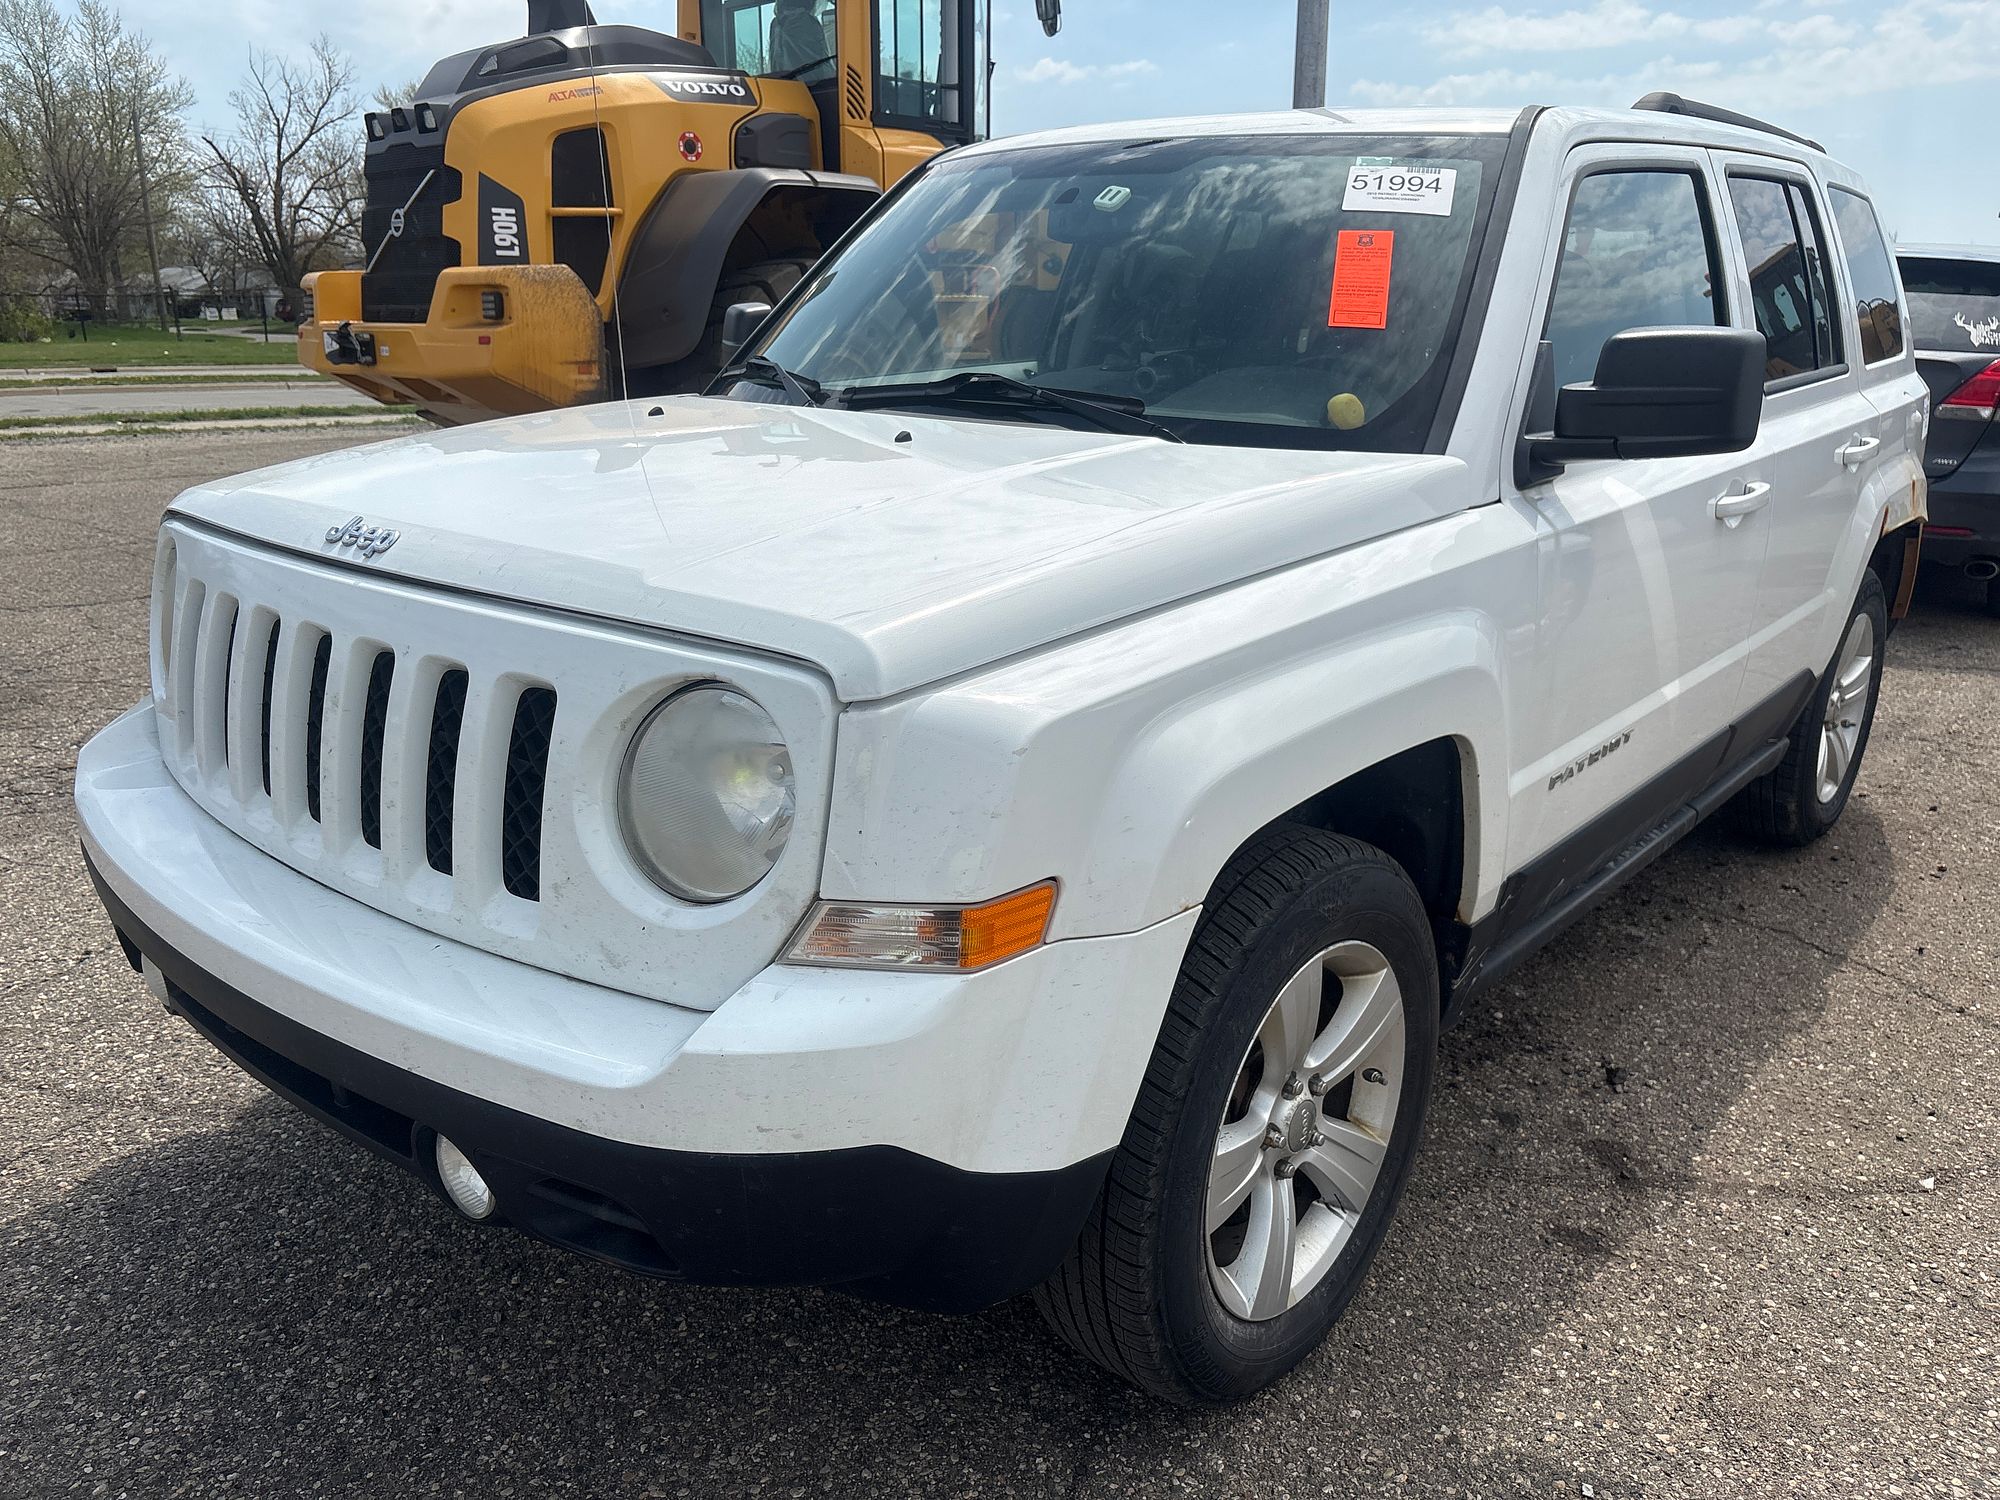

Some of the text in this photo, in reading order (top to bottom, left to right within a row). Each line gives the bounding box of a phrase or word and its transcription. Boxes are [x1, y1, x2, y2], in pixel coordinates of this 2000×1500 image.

[548, 89, 577, 103] ALTA
[661, 79, 746, 97] VOLVO
[1351, 174, 1442, 193] 51994
[491, 207, 521, 257] L90H
[324, 515, 401, 558] Jeep
[1548, 728, 1634, 791] PATRIOT
